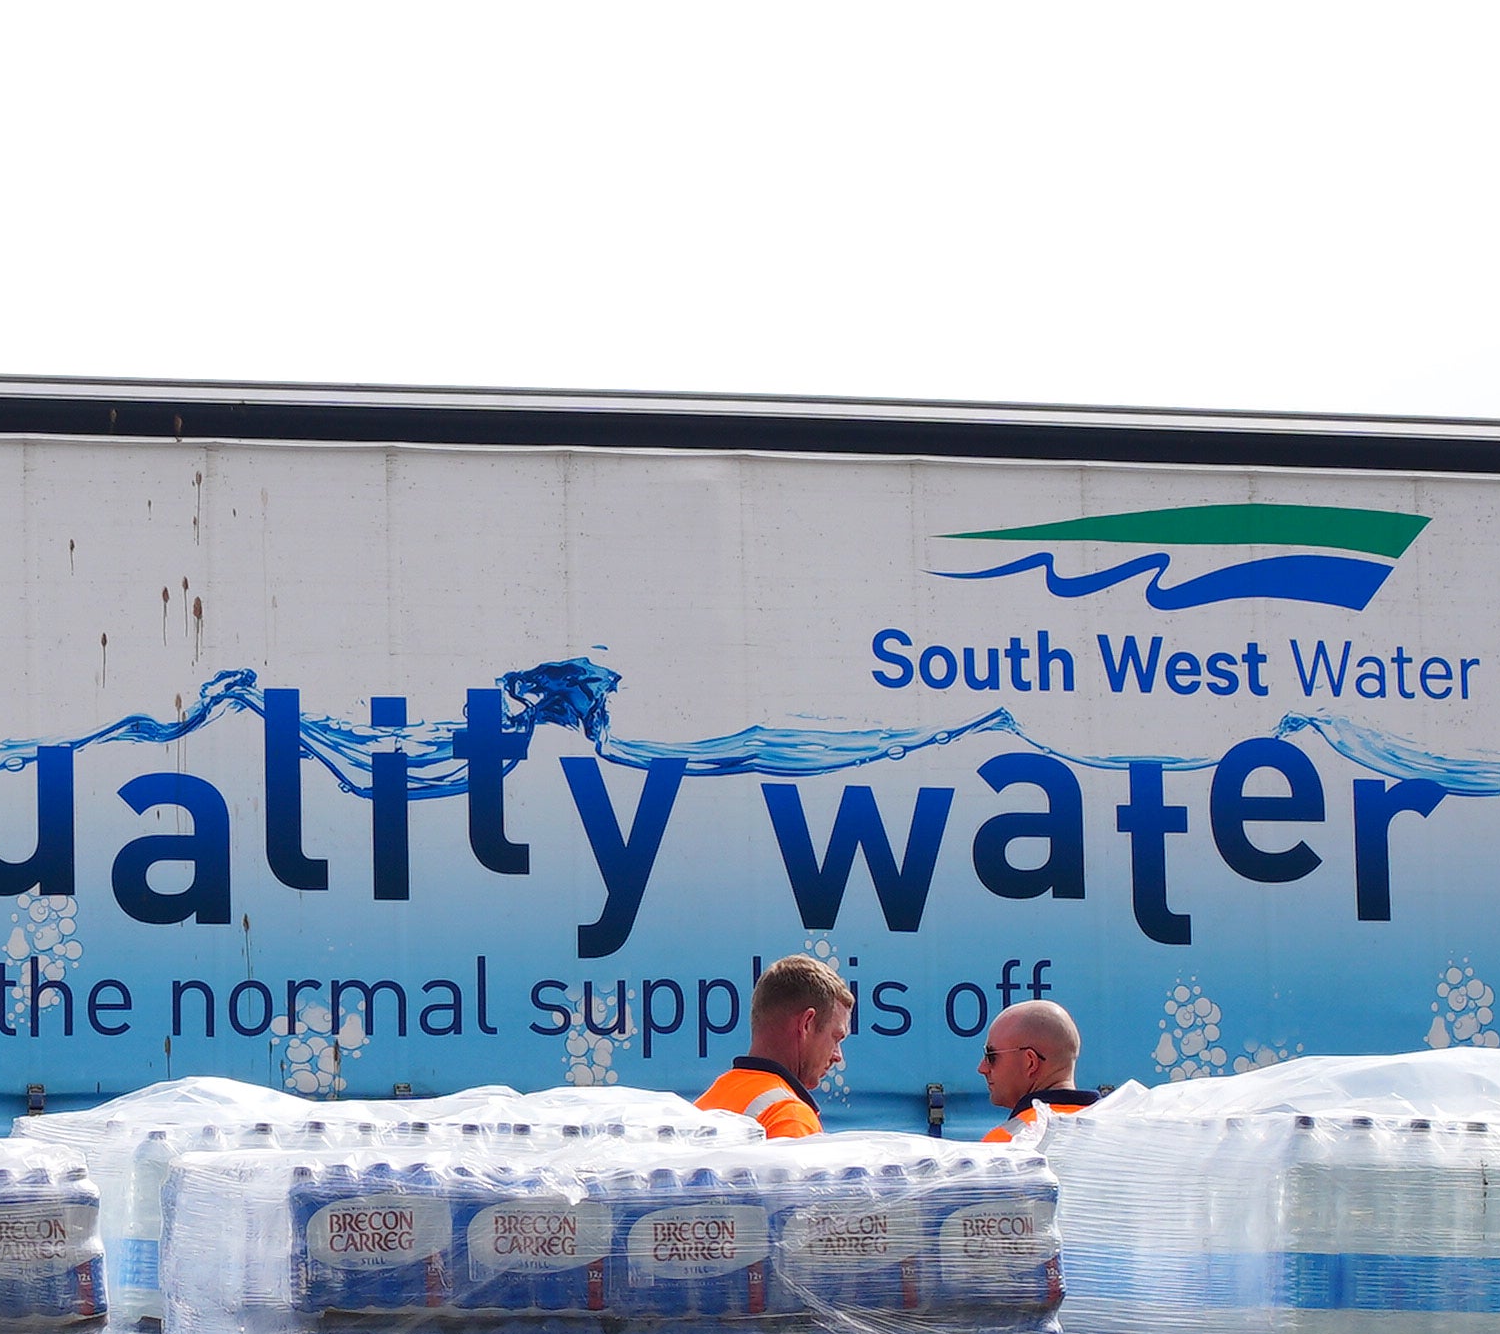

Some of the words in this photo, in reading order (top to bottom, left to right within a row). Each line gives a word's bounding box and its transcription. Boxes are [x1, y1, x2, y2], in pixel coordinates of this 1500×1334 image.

[871, 628, 1076, 694] South
[1094, 634, 1268, 698] West
[1288, 639, 1481, 703] Water
[763, 737, 1448, 946] water
[170, 959, 496, 1037] normal
[528, 955, 761, 1058] supp
[850, 956, 912, 1036] is
[946, 959, 1053, 1038] off
[329, 1211, 413, 1233] BRECON
[494, 1216, 576, 1235] BRECON
[653, 1221, 735, 1241] BRECON
[963, 1217, 1033, 1237] BRECON
[329, 1233, 415, 1252] CARREG
[494, 1236, 577, 1255] CARREG
[653, 1241, 737, 1261] CARREG
[361, 1257, 386, 1265] STILL
